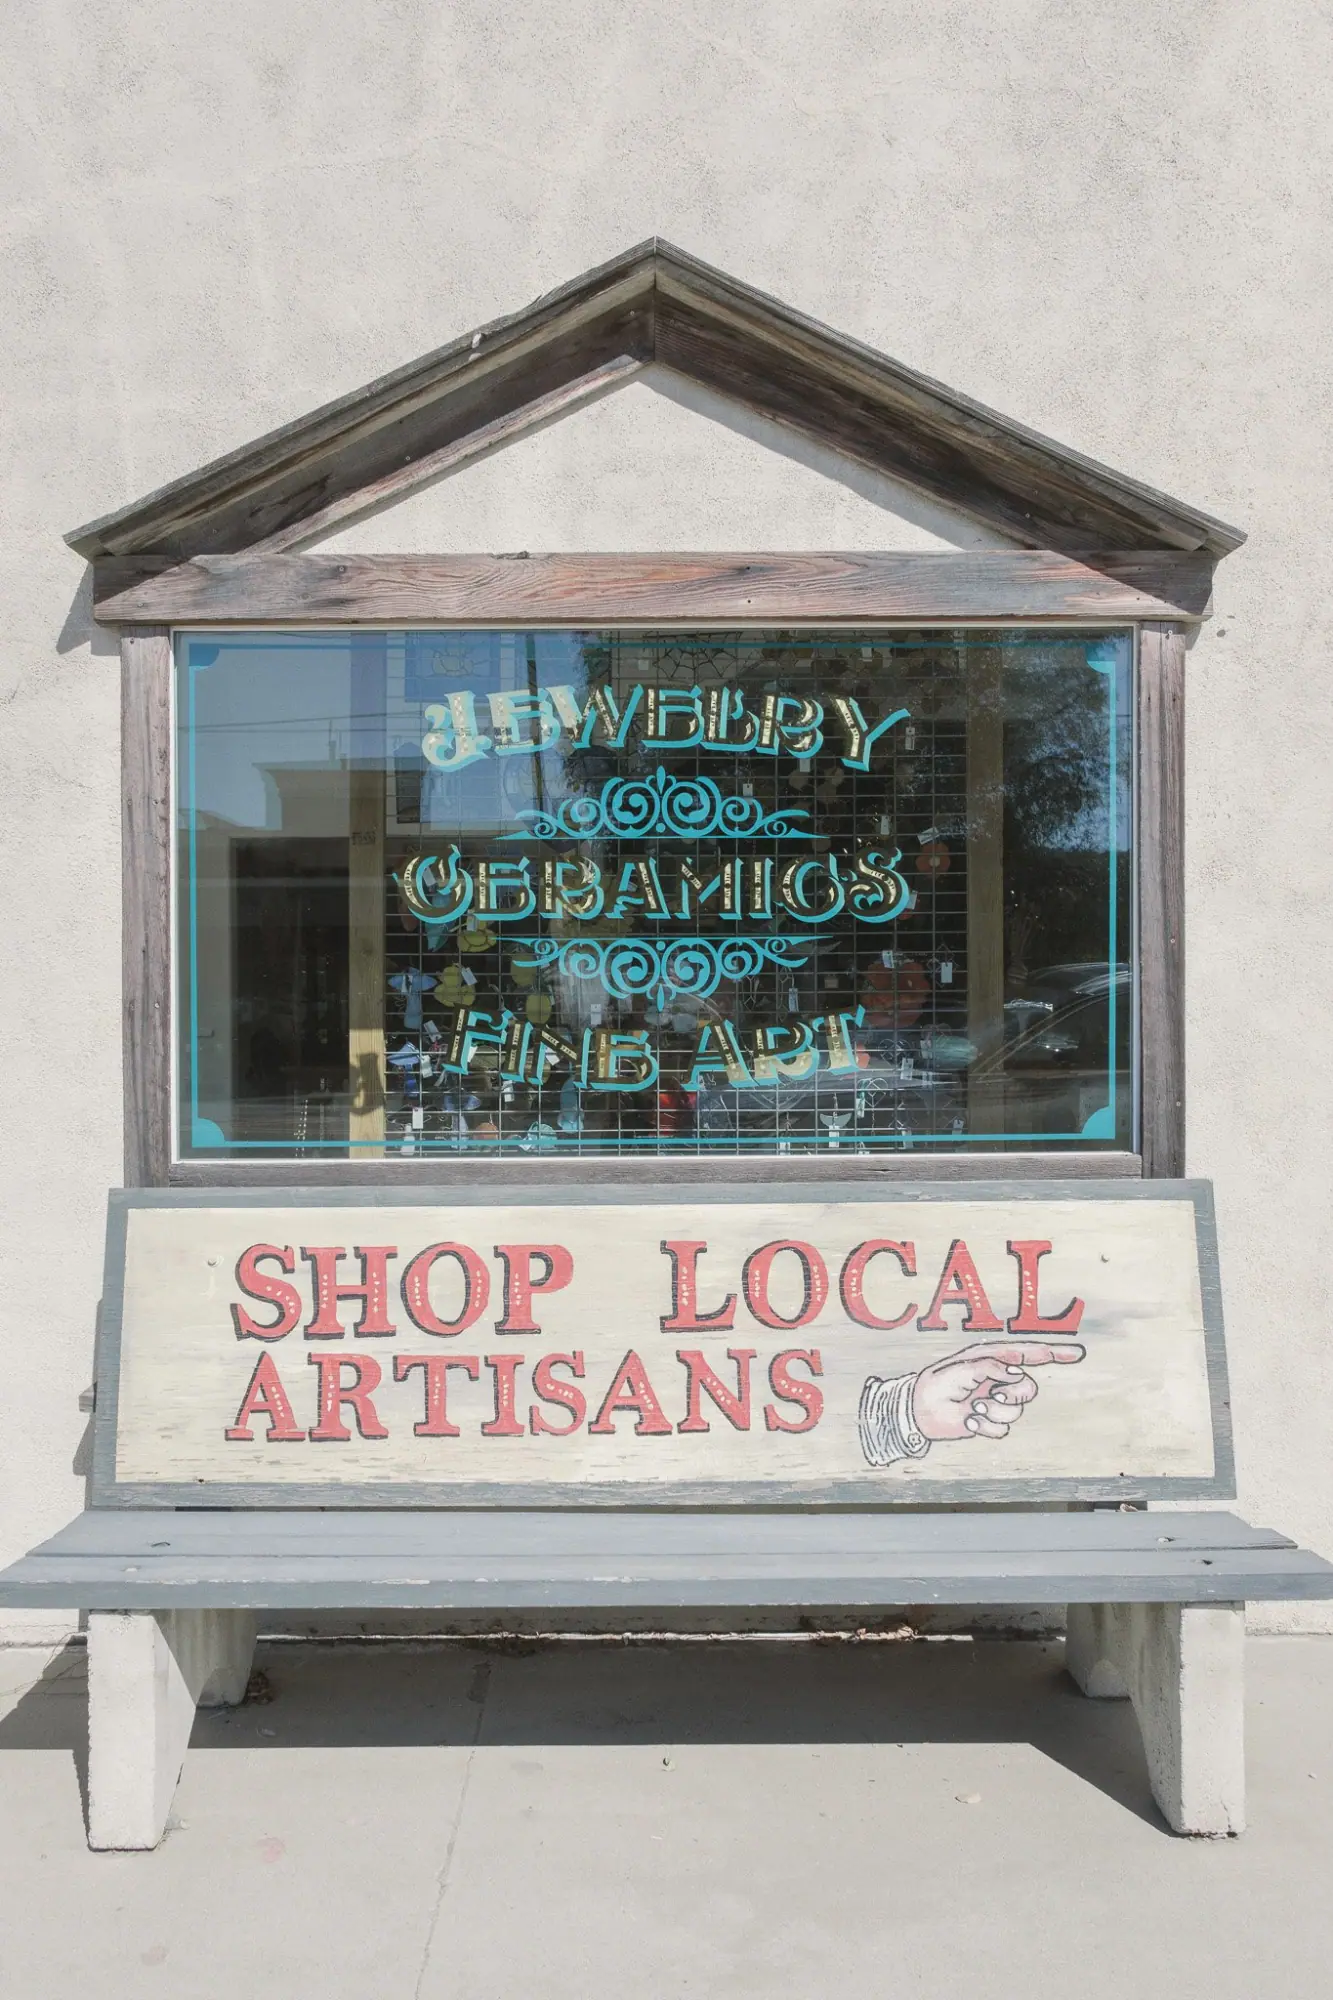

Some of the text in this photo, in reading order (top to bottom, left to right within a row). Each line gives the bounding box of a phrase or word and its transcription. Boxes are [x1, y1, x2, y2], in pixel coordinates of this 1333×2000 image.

[422, 684, 909, 771] JEWELRY
[393, 845, 910, 924] CERAMICS
[442, 1003, 866, 1091] FINE ART
[233, 1238, 1085, 1342] SHOP LOCAL
[225, 1348, 824, 1442] ARTISANS
